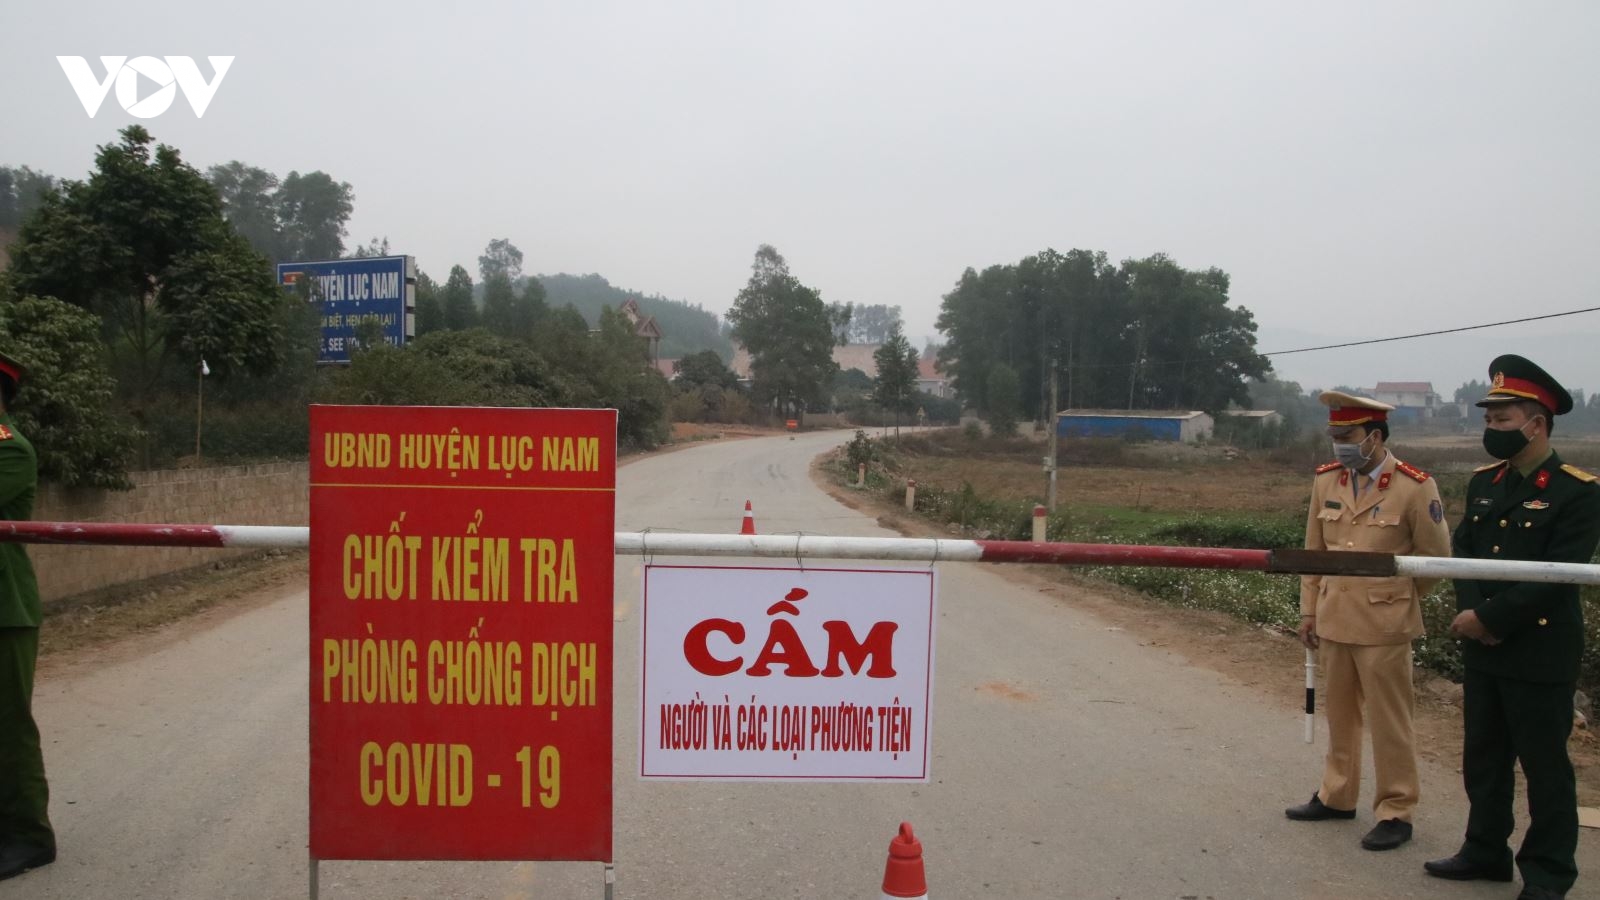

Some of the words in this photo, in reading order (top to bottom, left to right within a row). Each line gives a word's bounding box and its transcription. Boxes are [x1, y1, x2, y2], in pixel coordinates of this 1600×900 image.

[347, 272, 369, 307] LỤC
[372, 271, 399, 300] NAM
[328, 337, 344, 352] SEE
[325, 432, 391, 468] UBND
[399, 427, 480, 477] HUYỆN
[488, 435, 533, 478] LỤC
[542, 436, 599, 472] NAM
[343, 511, 422, 601] CHỐT
[432, 509, 509, 602] KIỂM
[520, 538, 578, 603] TRA
[683, 587, 899, 679] CẤM
[323, 623, 417, 704] PHÒNG
[427, 617, 522, 706] CHỐNG
[532, 642, 597, 721] DỊCH
[660, 691, 708, 751] NGƯỜI
[712, 694, 732, 751] VÀ
[737, 694, 768, 752] CÁC
[772, 705, 807, 761] LOẠI
[810, 700, 874, 753] PHƯƠNG
[877, 696, 912, 761] TIỆN
[360, 741, 473, 806] COVID
[516, 745, 561, 808] 19
